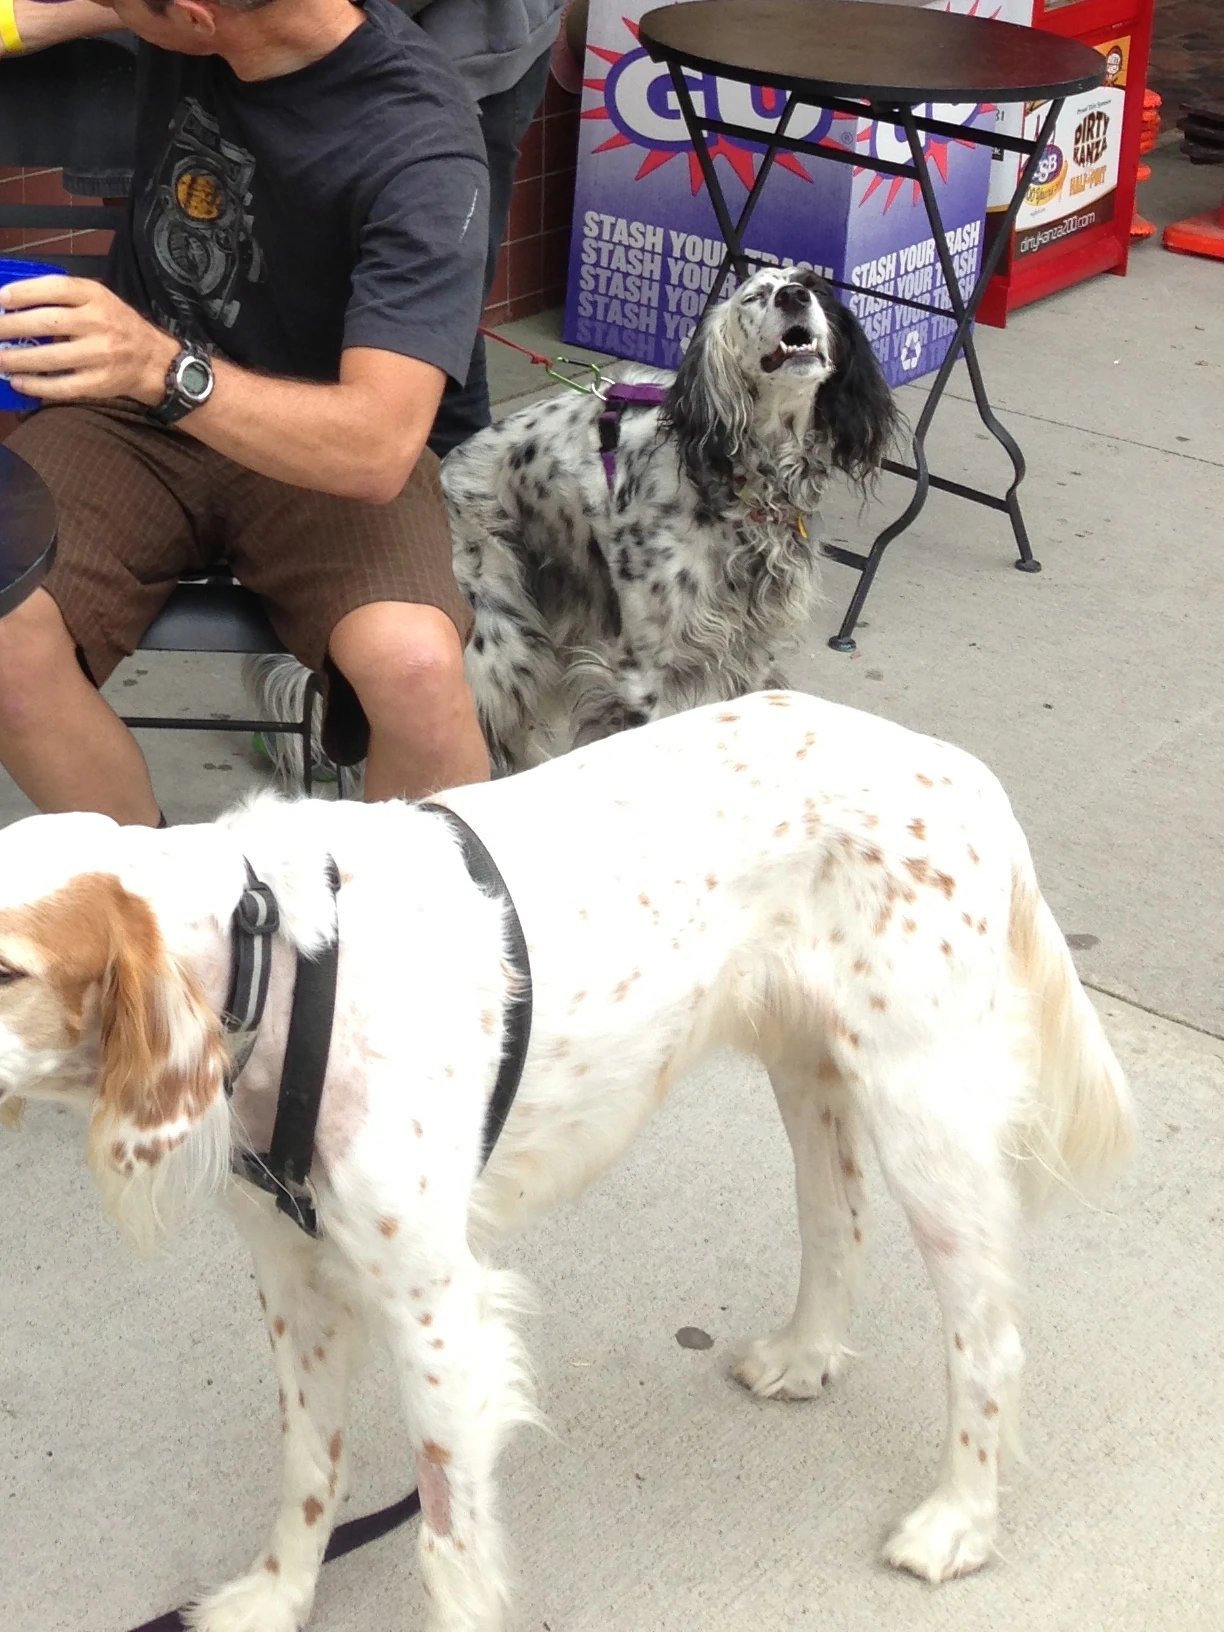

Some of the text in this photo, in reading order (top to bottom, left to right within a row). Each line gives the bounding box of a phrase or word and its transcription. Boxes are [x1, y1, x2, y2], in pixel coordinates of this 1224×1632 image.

[1075, 111, 1110, 146] DIRTY
[1073, 136, 1108, 168] KANZA
[584, 211, 663, 254] STASH
[1020, 212, 1096, 253] dirtykanza200.com
[582, 238, 661, 281] STASH
[851, 253, 897, 294] STASH
[899, 237, 935, 272] YOUR
[897, 264, 933, 300] YOUR
[935, 248, 977, 286] TASH
[578, 291, 658, 334] STASH
[580, 265, 709, 321] STASH YO
[576, 317, 656, 361] STASH
